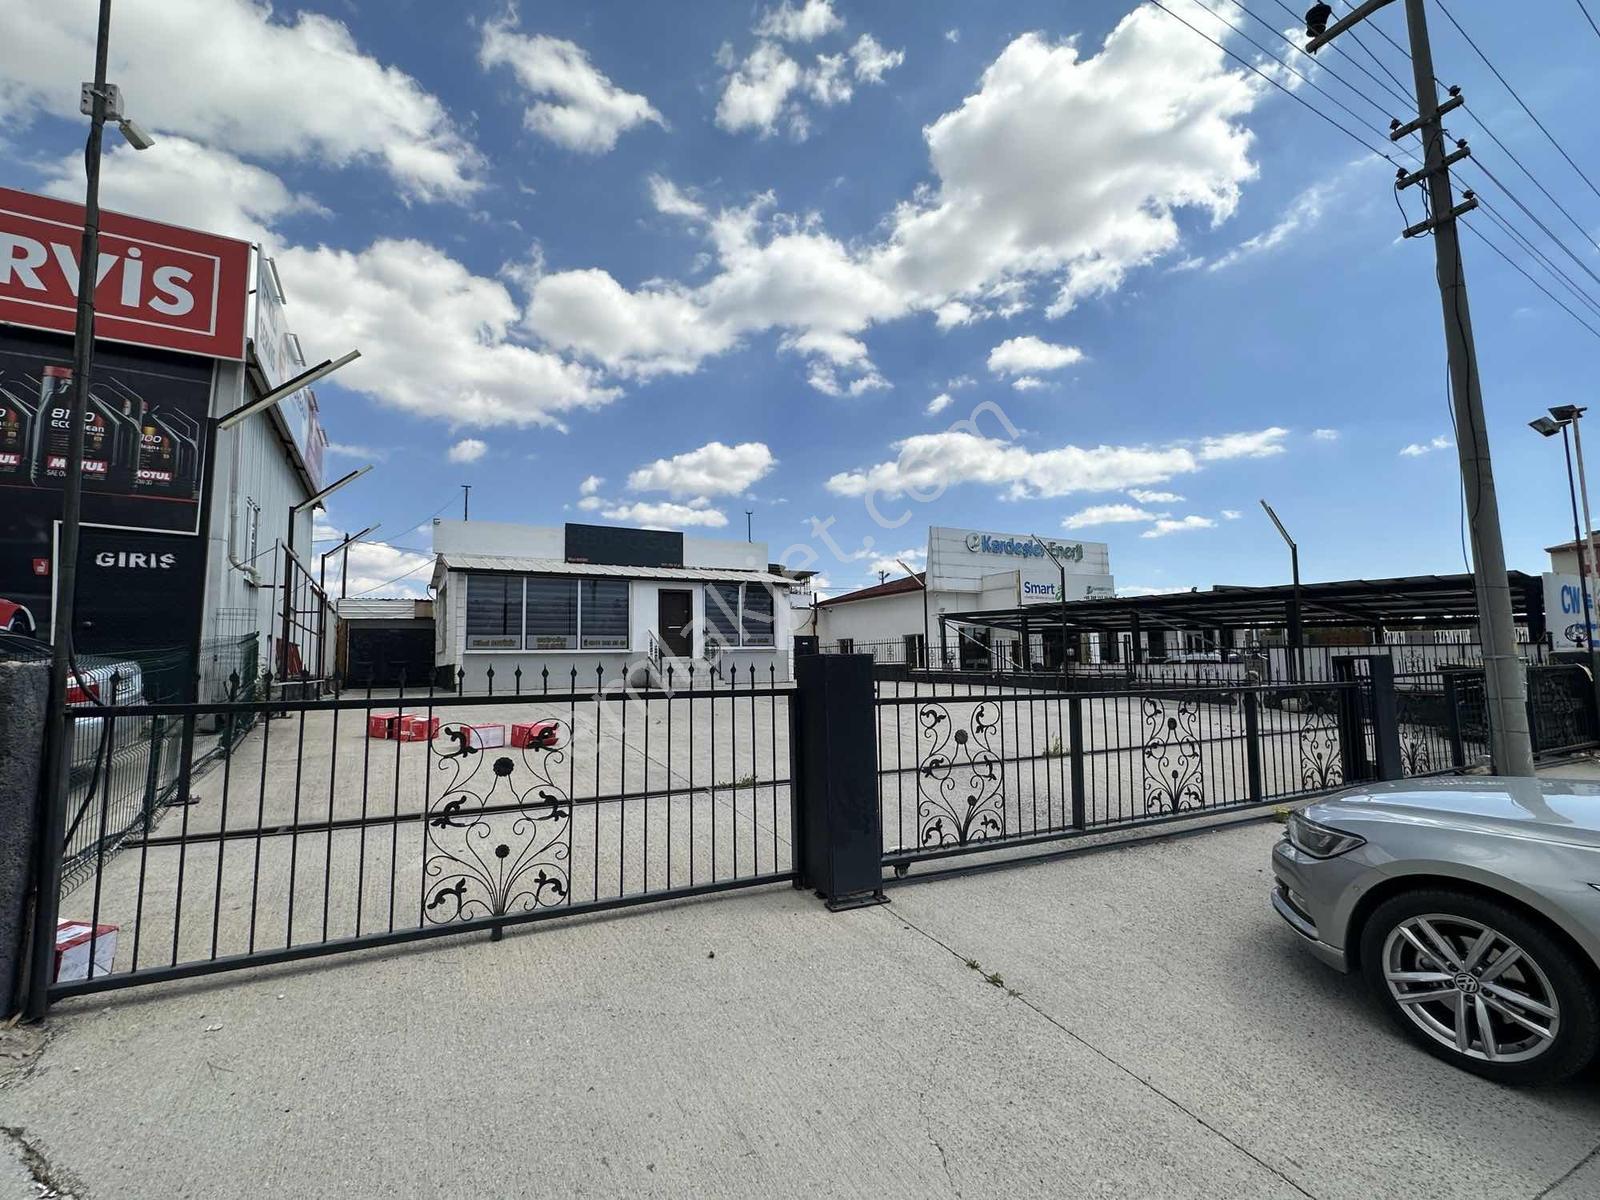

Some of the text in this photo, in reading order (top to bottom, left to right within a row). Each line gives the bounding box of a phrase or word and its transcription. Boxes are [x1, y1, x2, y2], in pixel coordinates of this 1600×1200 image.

[51, 408, 96, 422] 810
[50, 458, 105, 472] MTUL
[1024, 581, 1055, 595] Smart
